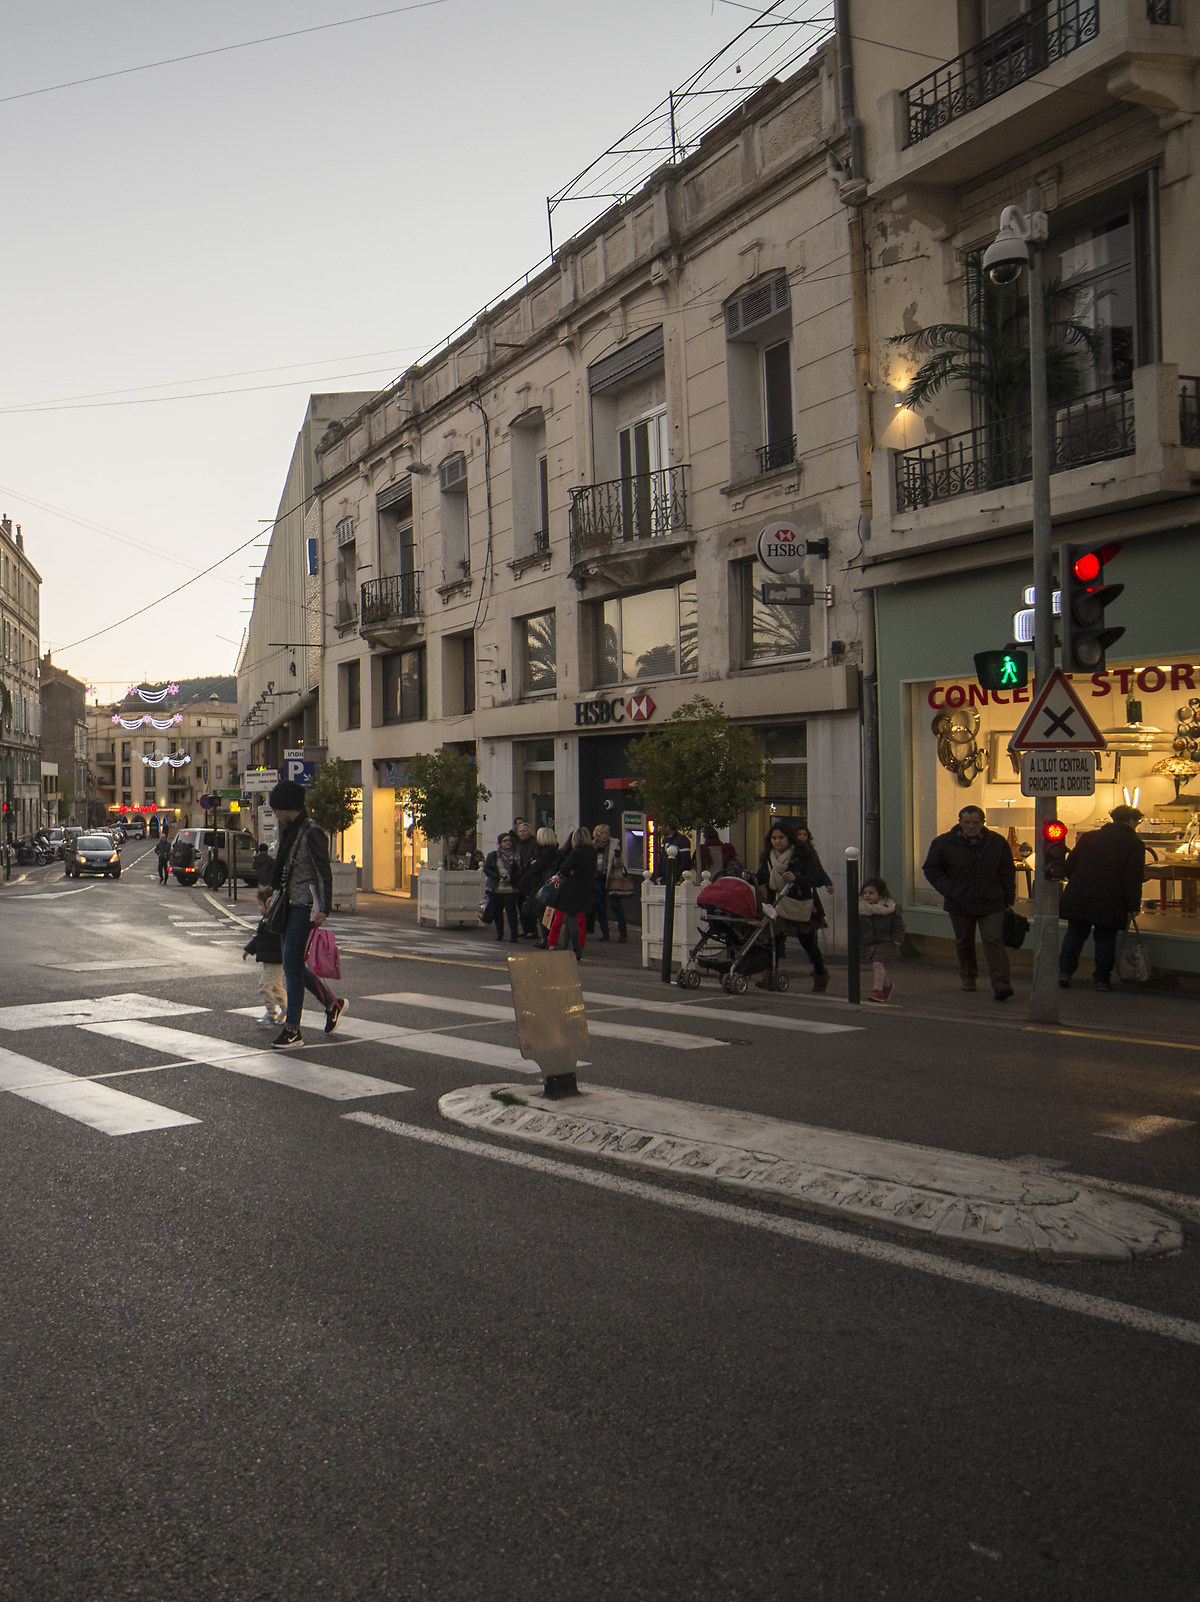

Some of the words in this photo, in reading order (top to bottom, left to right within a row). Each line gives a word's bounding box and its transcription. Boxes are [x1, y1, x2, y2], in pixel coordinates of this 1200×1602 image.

[767, 543, 806, 557] HSBC
[928, 674, 1073, 709] CONCE
[1091, 663, 1200, 697] STOR
[574, 697, 624, 726] HSBC
[1030, 758, 1035, 772] A
[1037, 758, 1057, 772] L'ILOT
[1060, 758, 1089, 772] CENTRAL
[1028, 776, 1058, 791] PRIORITE
[1060, 776, 1065, 791] A
[1067, 776, 1091, 791] DROITE
